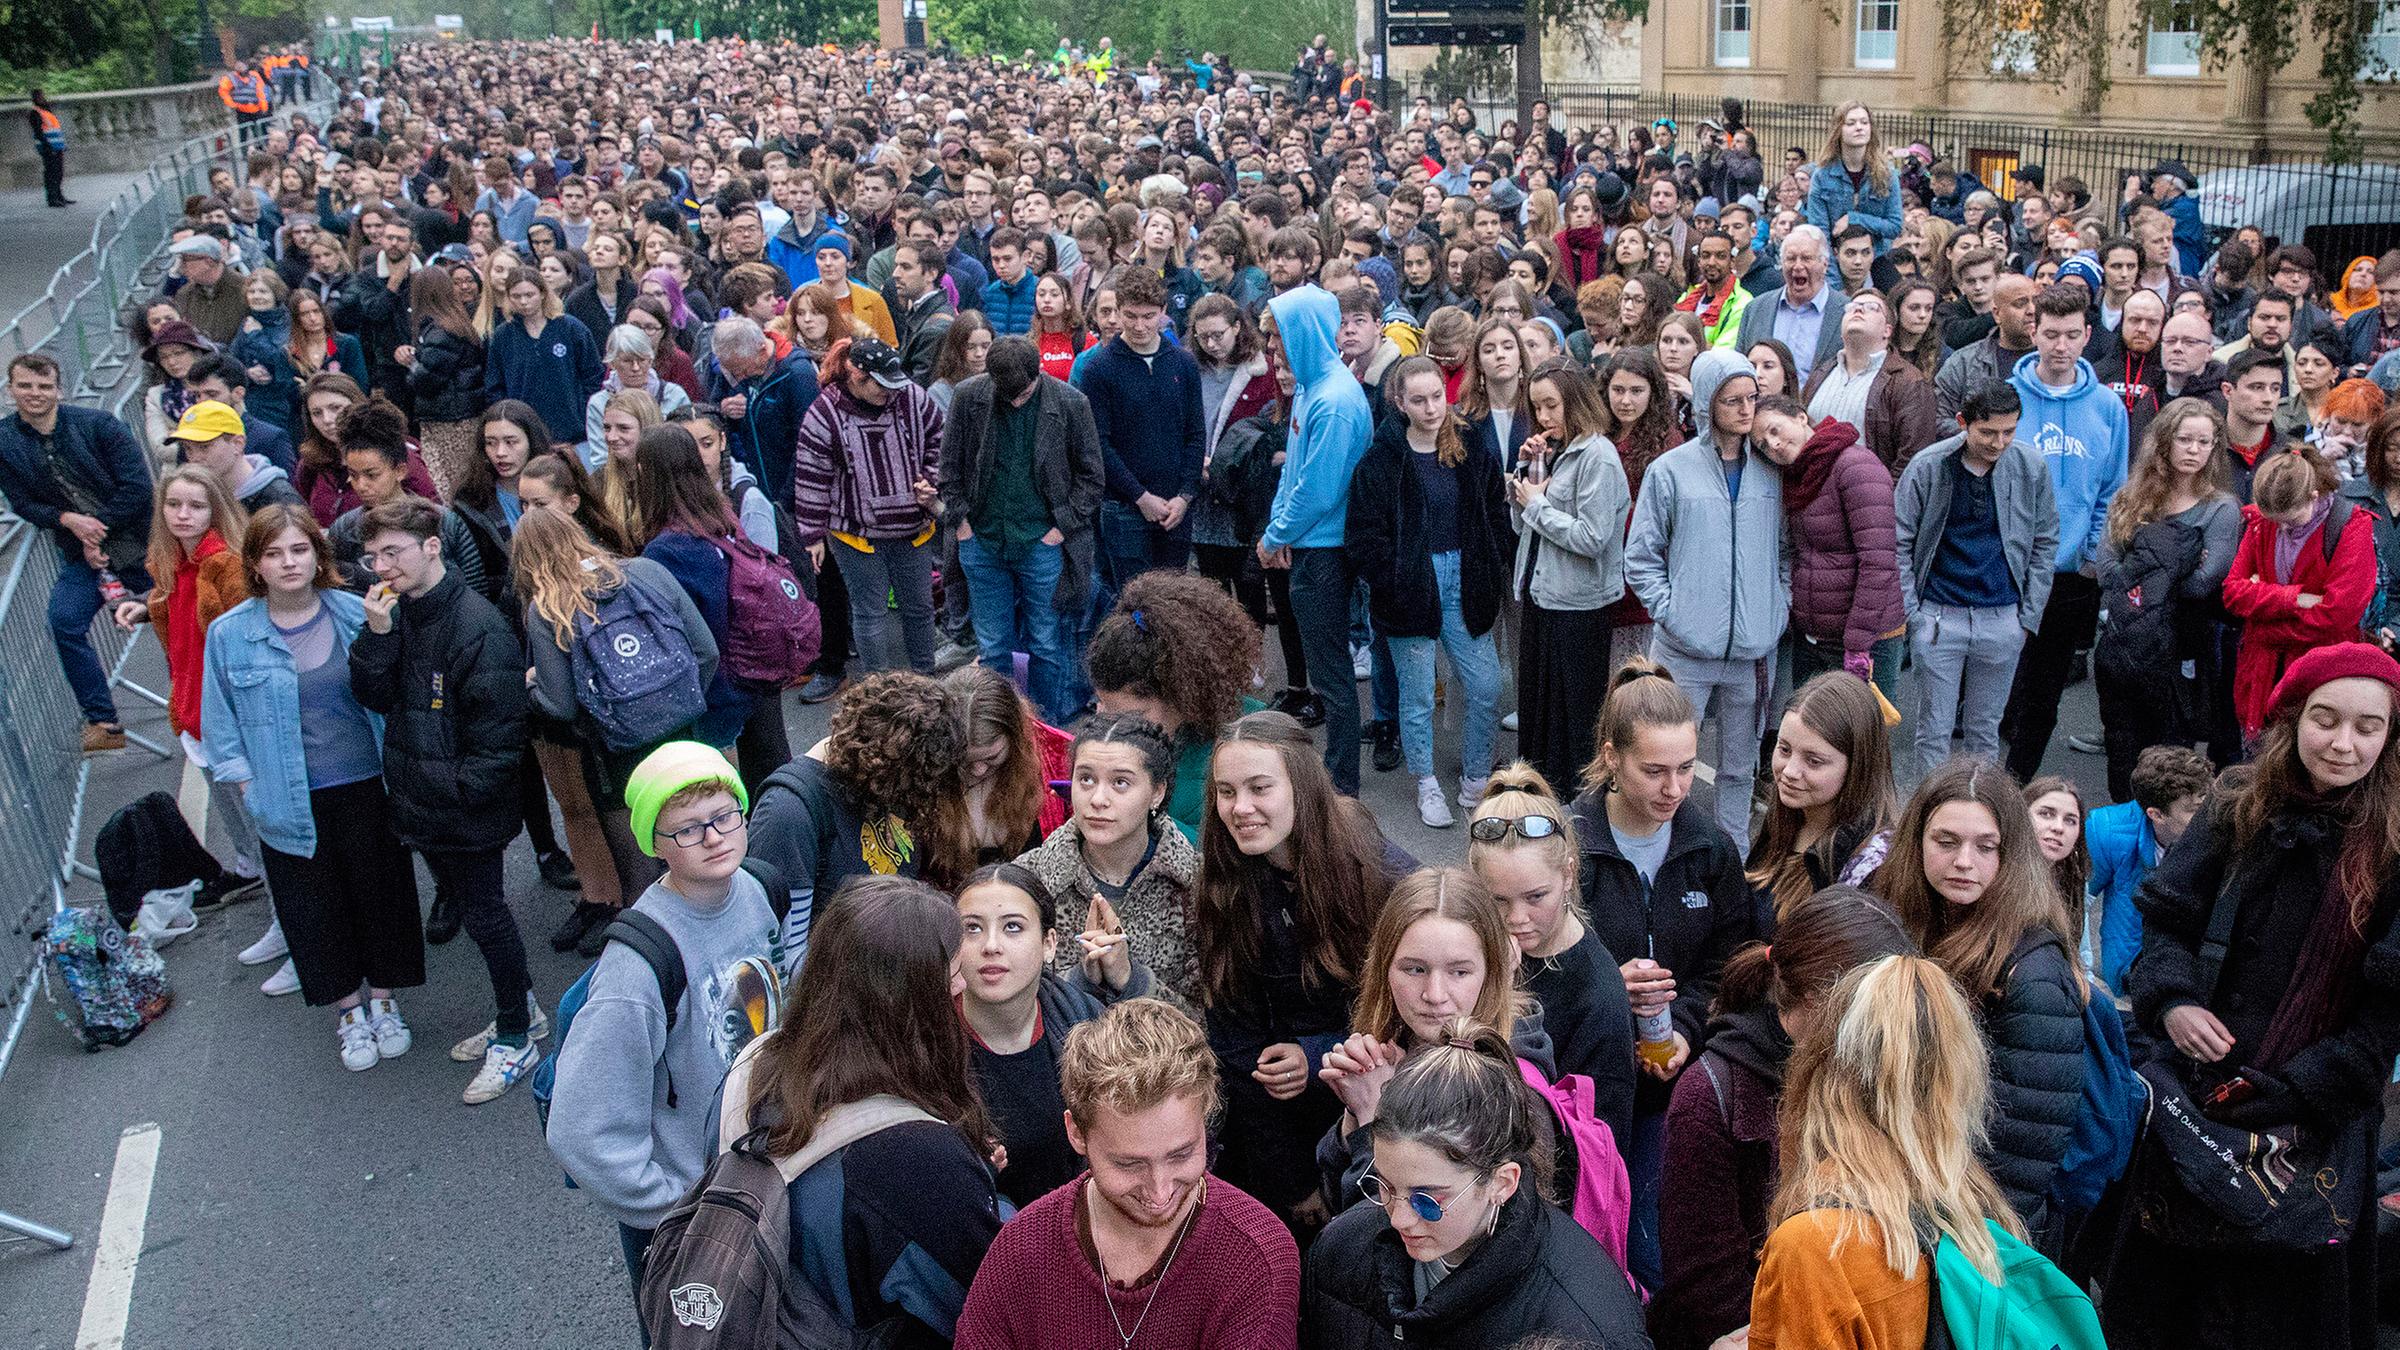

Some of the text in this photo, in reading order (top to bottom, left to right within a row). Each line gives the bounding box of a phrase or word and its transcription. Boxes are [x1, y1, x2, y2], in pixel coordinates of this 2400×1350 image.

[2181, 1115, 2201, 1136] avec
[2200, 1135, 2219, 1152] son
[687, 1288, 710, 1303] VANS
[689, 1301, 705, 1318] THE
